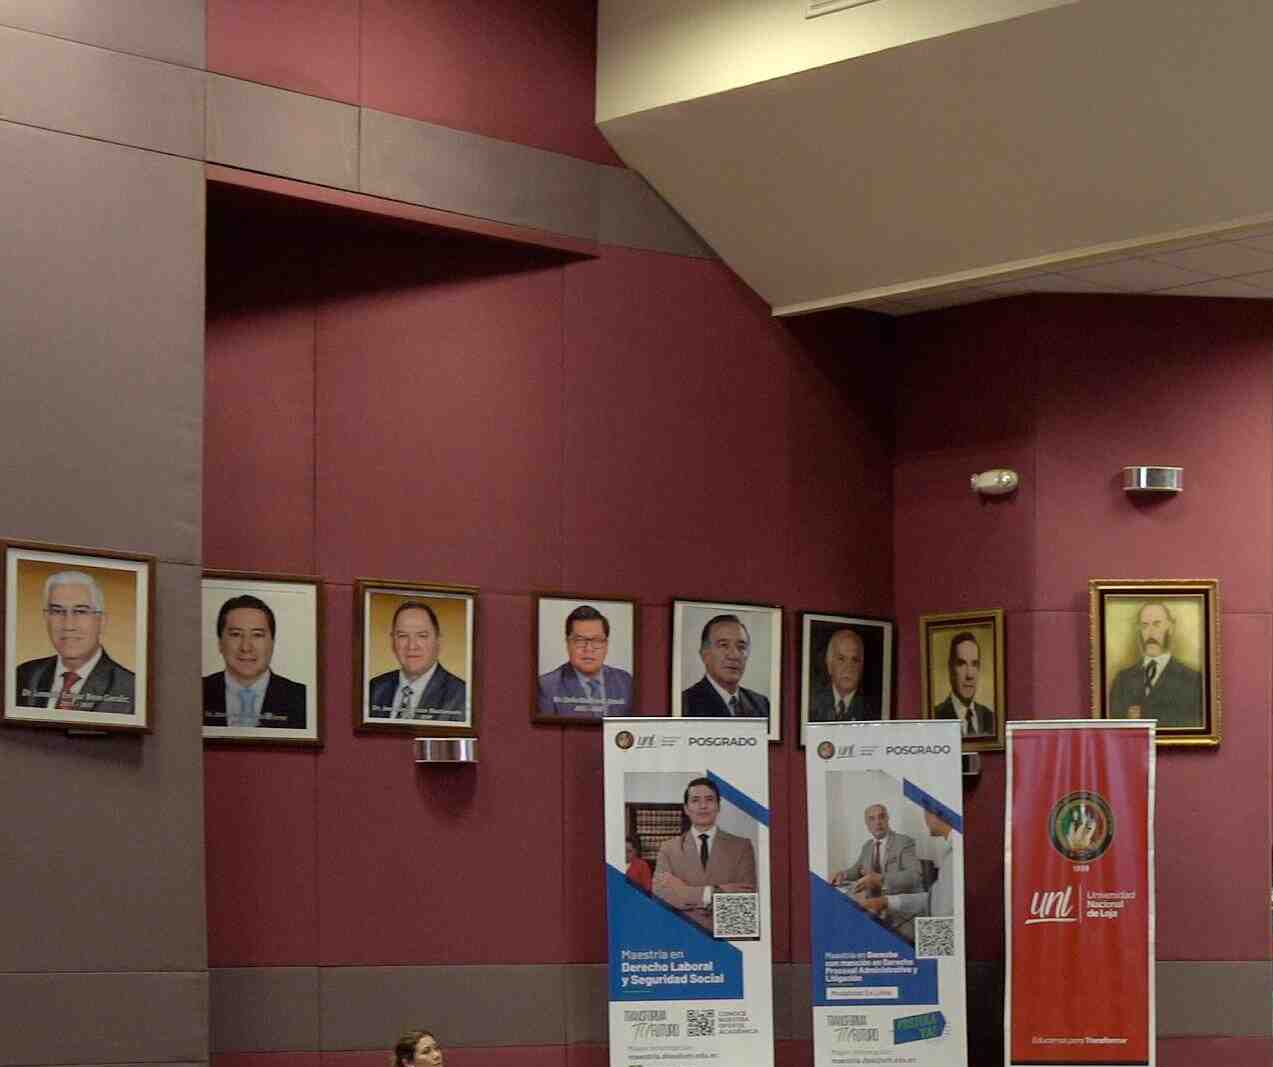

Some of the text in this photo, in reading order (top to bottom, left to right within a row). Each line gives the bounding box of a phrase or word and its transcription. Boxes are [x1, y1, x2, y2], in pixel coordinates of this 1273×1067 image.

[688, 737, 757, 747] POSGRADO
[886, 744, 951, 756] POSGRADO
[1087, 900, 1124, 909] Nacional
[1086, 909, 1119, 920] de Loja
[621, 960, 714, 972] Derecho Laboral
[621, 973, 725, 987] y Seguridad Social
